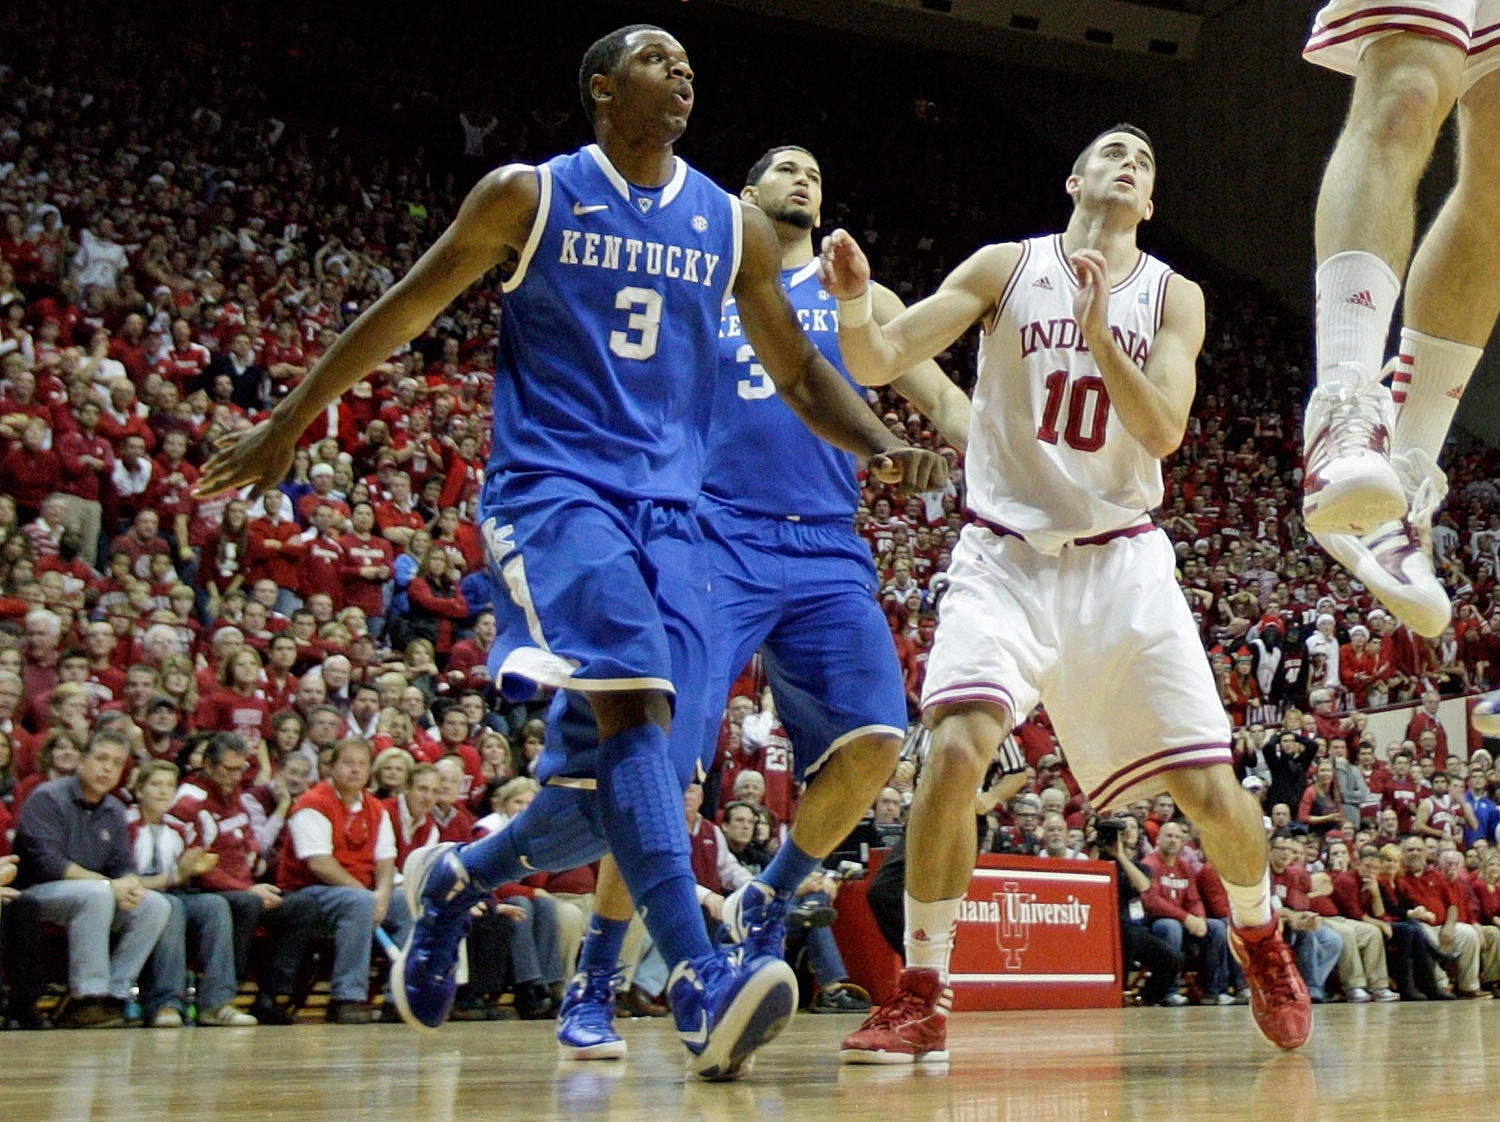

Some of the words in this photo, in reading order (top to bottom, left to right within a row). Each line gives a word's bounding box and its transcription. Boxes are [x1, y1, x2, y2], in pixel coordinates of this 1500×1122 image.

[558, 229, 722, 287] KENTUCKY
[609, 285, 664, 361] 3
[1020, 318, 1149, 371] INDINA
[1037, 370, 1111, 453] 10
[957, 899, 1000, 923] iana
[1007, 893, 1091, 931] University
